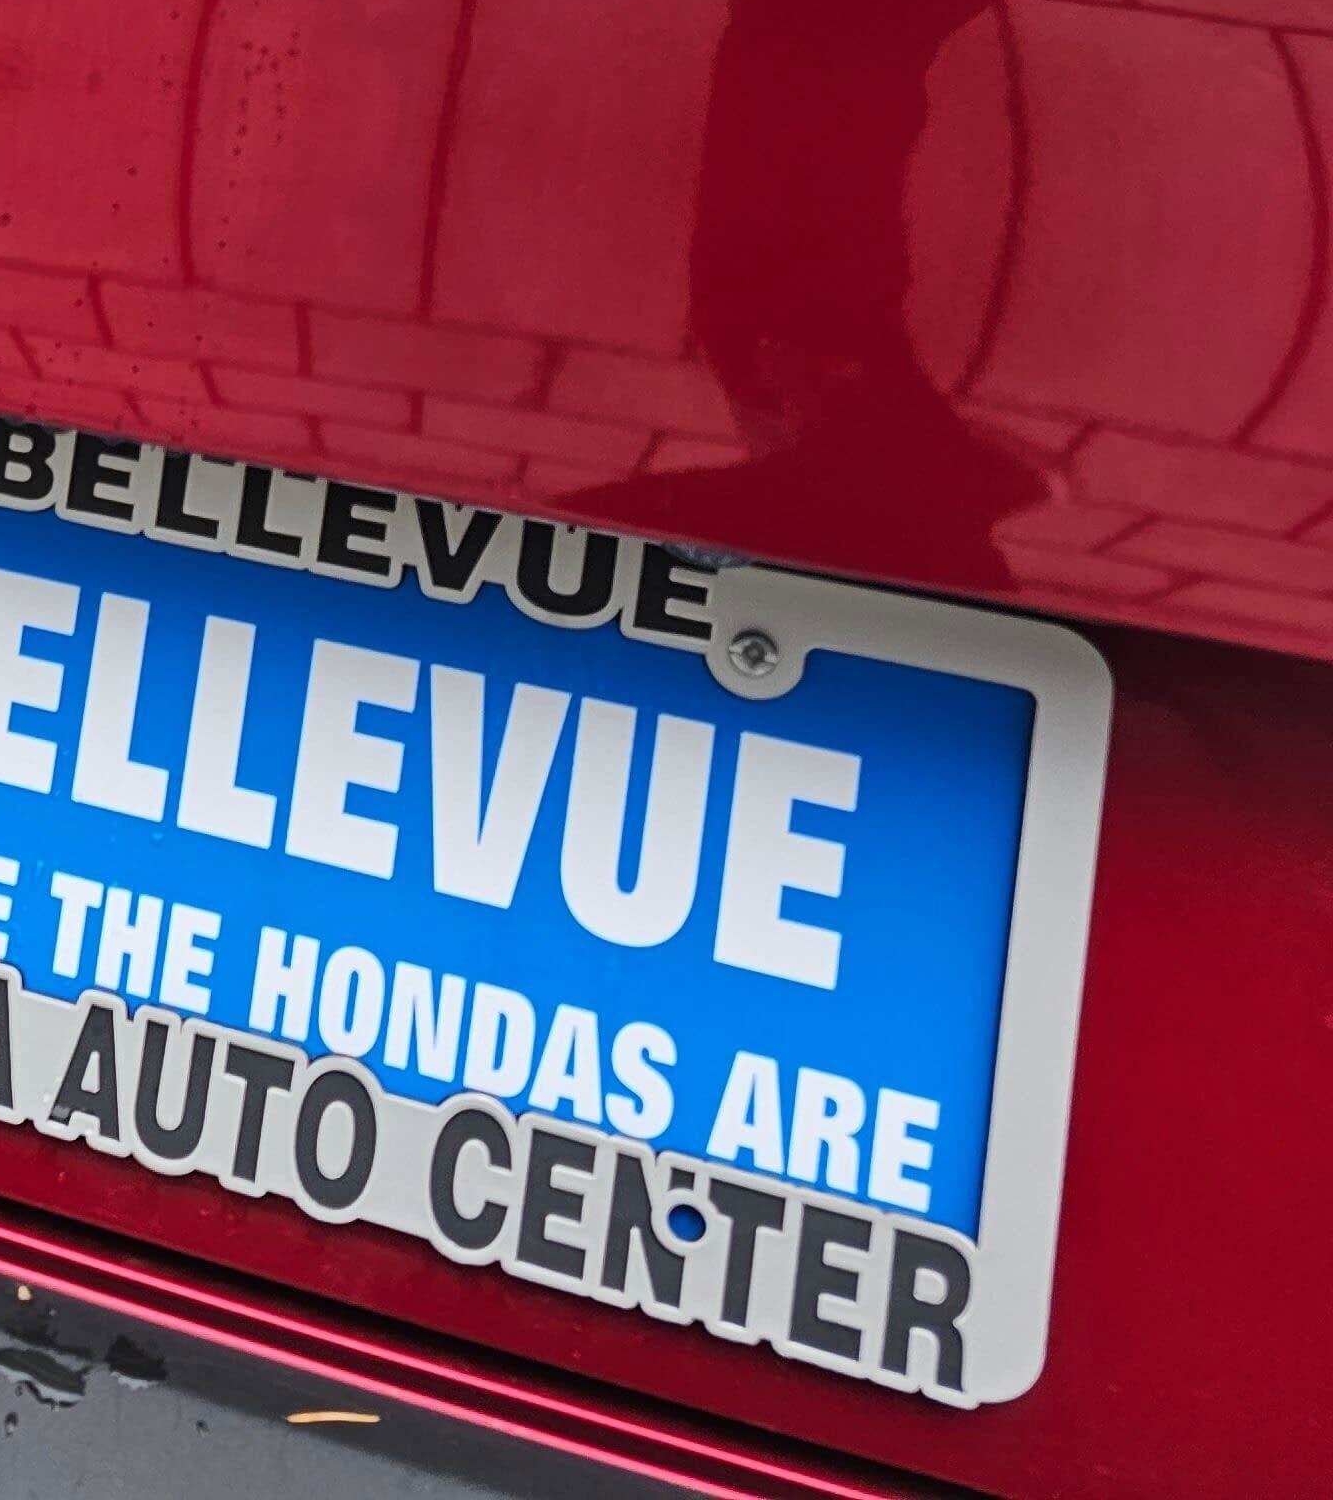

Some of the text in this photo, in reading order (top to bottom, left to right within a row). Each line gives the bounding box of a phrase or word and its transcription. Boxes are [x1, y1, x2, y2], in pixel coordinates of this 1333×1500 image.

[48, 995, 377, 1210] AUTO
[431, 1108, 972, 1393] CENTER
[50, 871, 222, 1014] THE
[248, 926, 678, 1140] HONDAS
[706, 1050, 941, 1213] ARE
